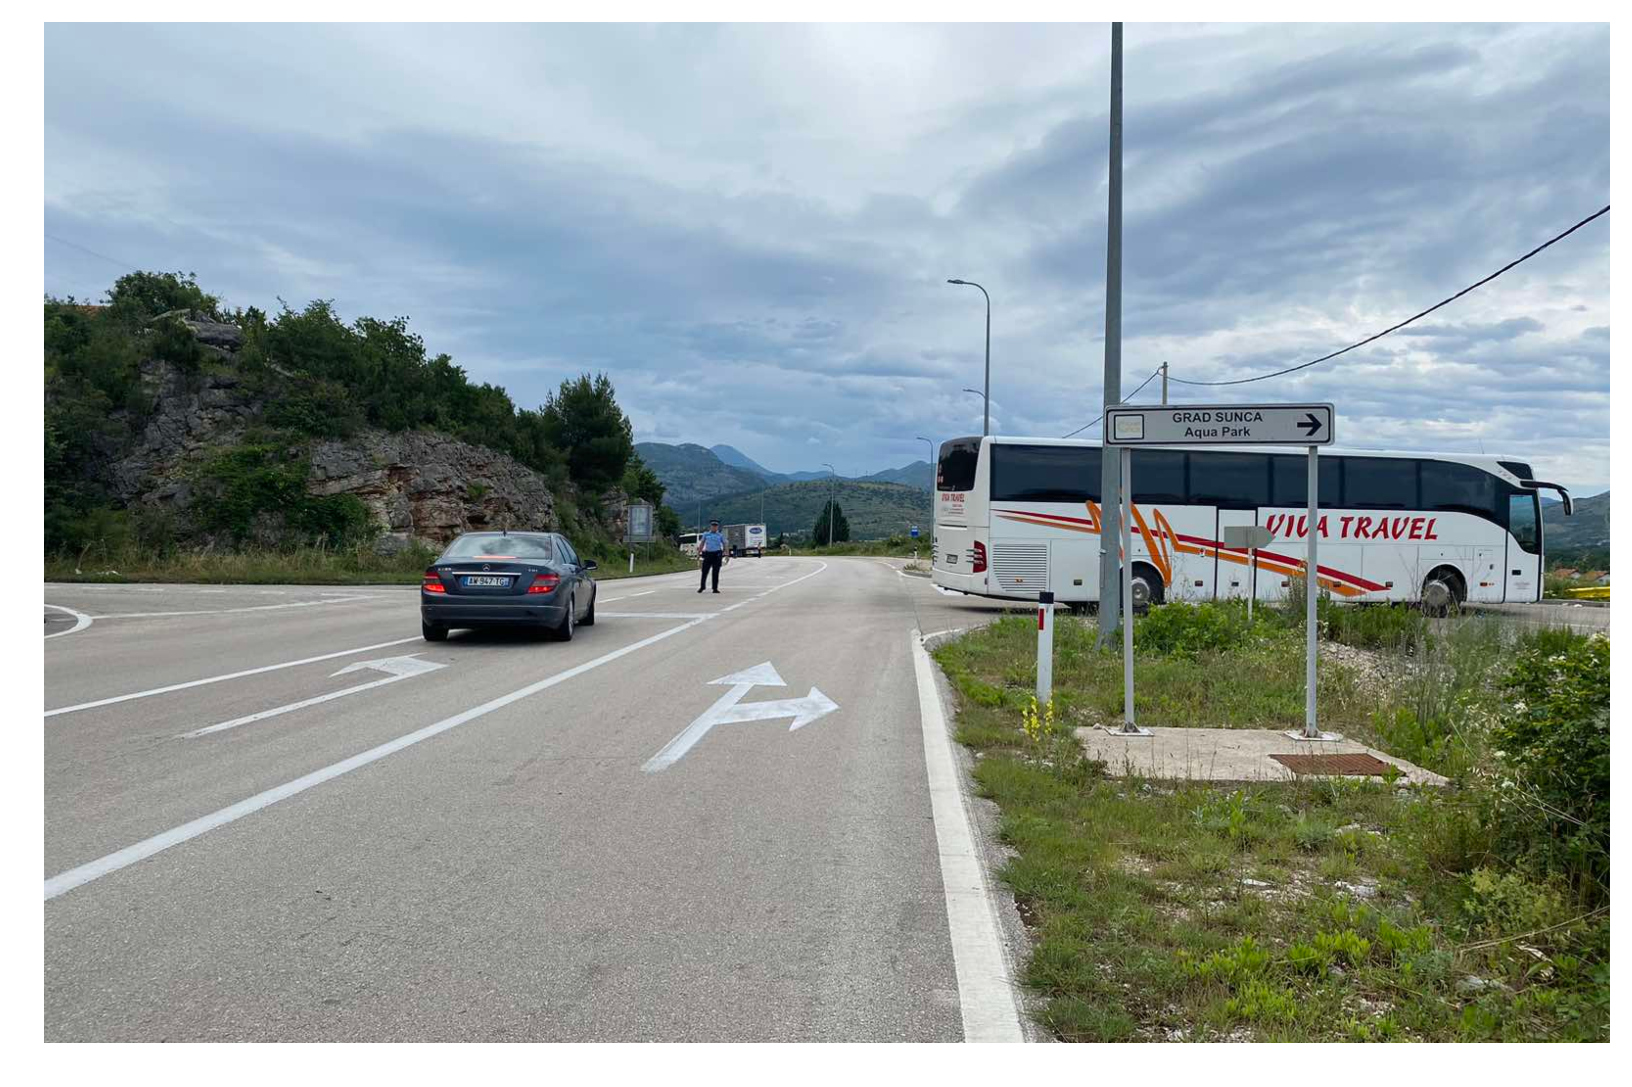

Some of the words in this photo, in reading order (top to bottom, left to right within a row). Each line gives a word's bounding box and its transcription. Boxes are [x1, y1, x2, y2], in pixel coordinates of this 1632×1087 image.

[1172, 412, 1211, 423] GRAD
[1215, 411, 1263, 423] SUNCA
[1184, 427, 1218, 438] Aqua
[1222, 426, 1250, 437] Park
[1340, 516, 1438, 540] TRAVEL
